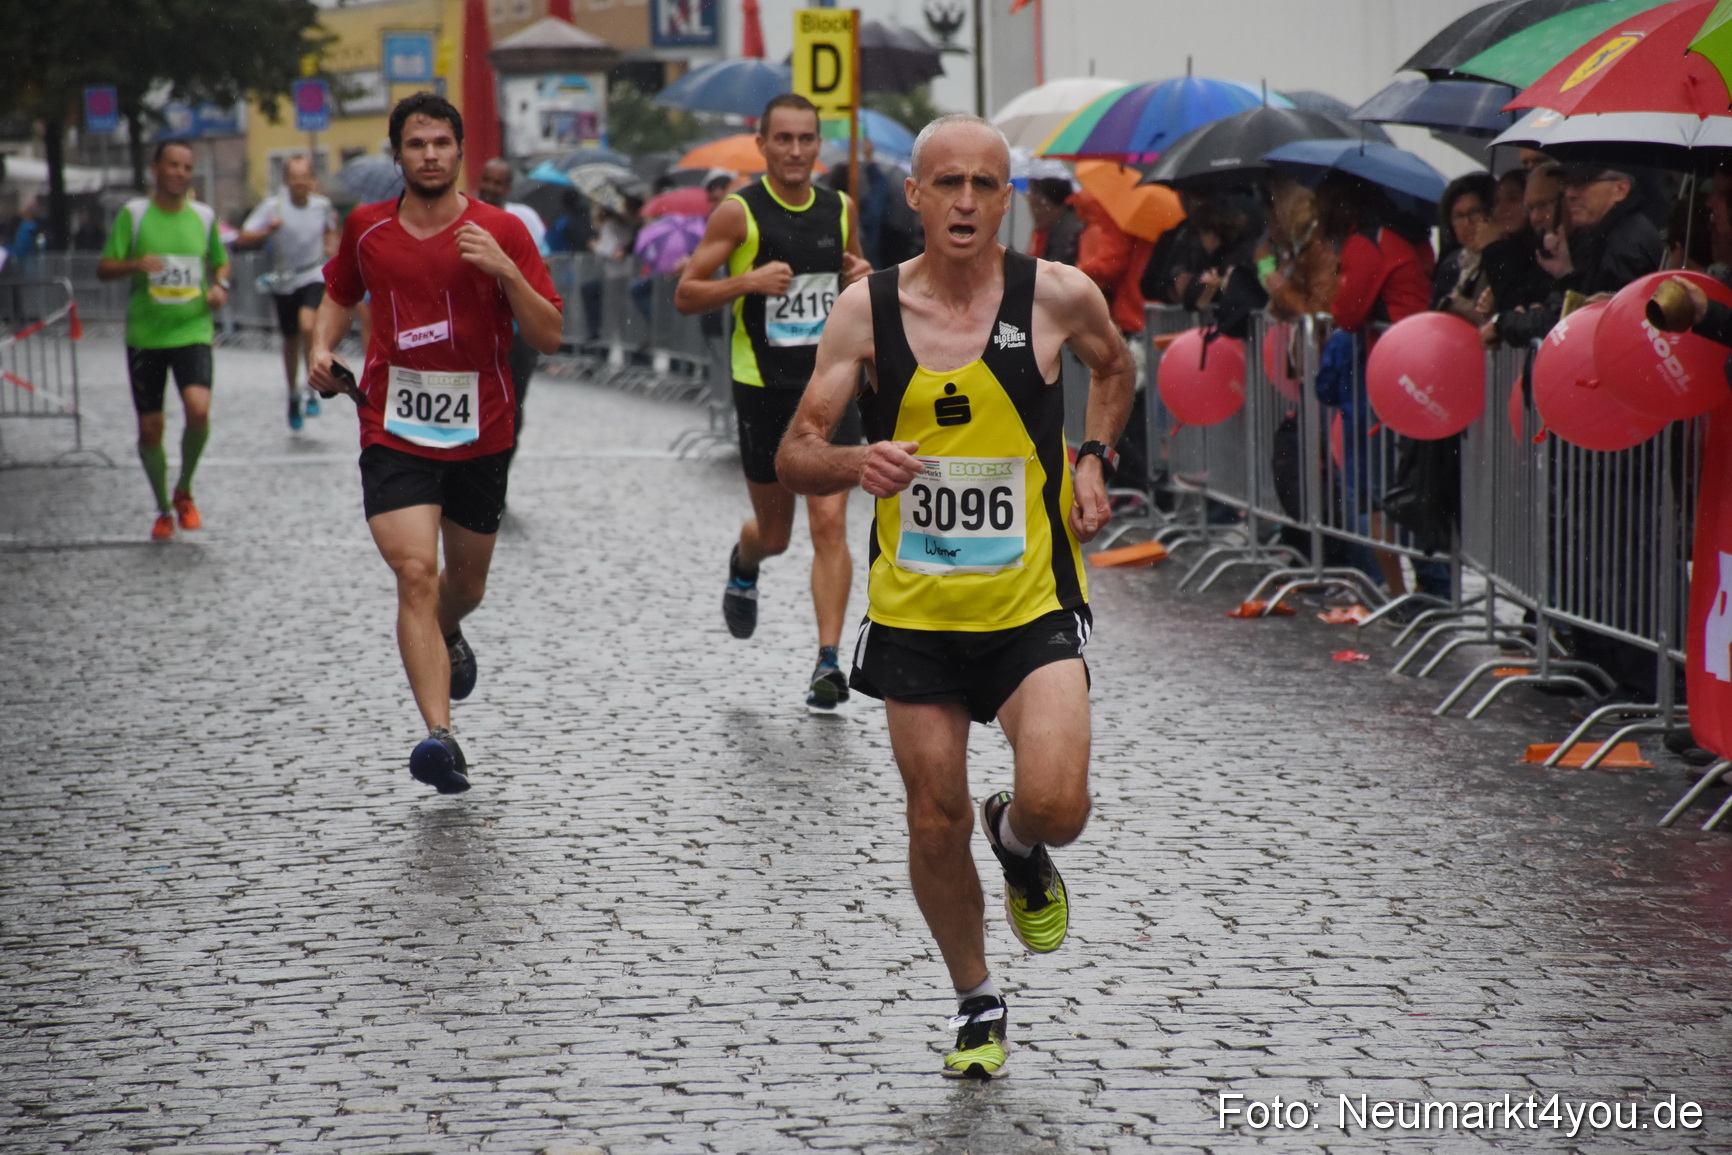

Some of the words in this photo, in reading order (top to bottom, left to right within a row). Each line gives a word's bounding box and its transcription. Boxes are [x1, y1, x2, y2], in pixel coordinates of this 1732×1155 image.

[802, 13, 852, 33] Block
[811, 43, 841, 93] D
[775, 292, 834, 319] 2416
[411, 330, 435, 343] DEHN
[993, 332, 1026, 344] BLOEMEN
[428, 375, 470, 386] BOCK
[396, 389, 471, 424] 3024
[949, 462, 1013, 476] BOCK
[912, 484, 1014, 532] 3096
